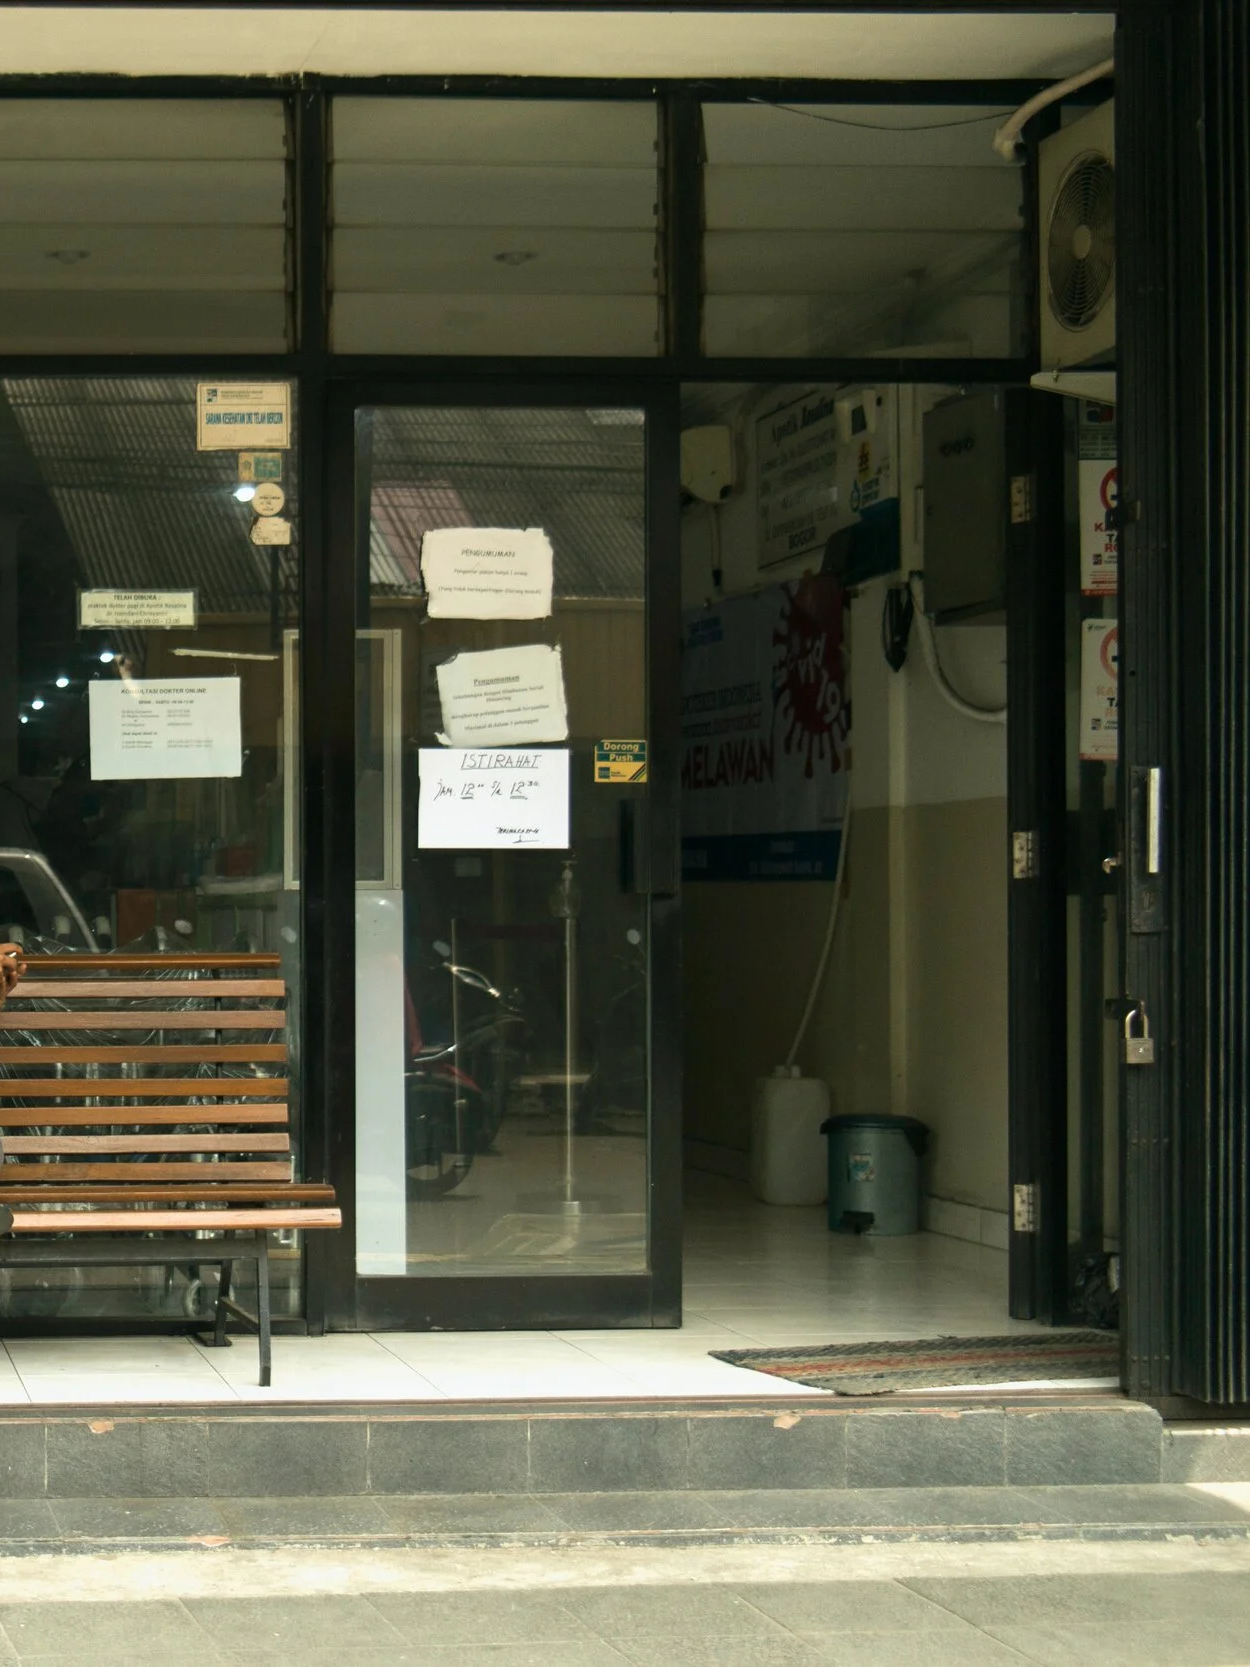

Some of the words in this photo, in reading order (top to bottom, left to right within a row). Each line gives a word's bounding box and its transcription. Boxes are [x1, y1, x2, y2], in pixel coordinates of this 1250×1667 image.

[461, 549, 516, 558] PENGUMUMAN
[473, 675, 520, 687] Pengumuman
[603, 742, 639, 753] Dorong
[461, 754, 542, 769] ISTIRAHAT
[609, 753, 633, 762] Push
